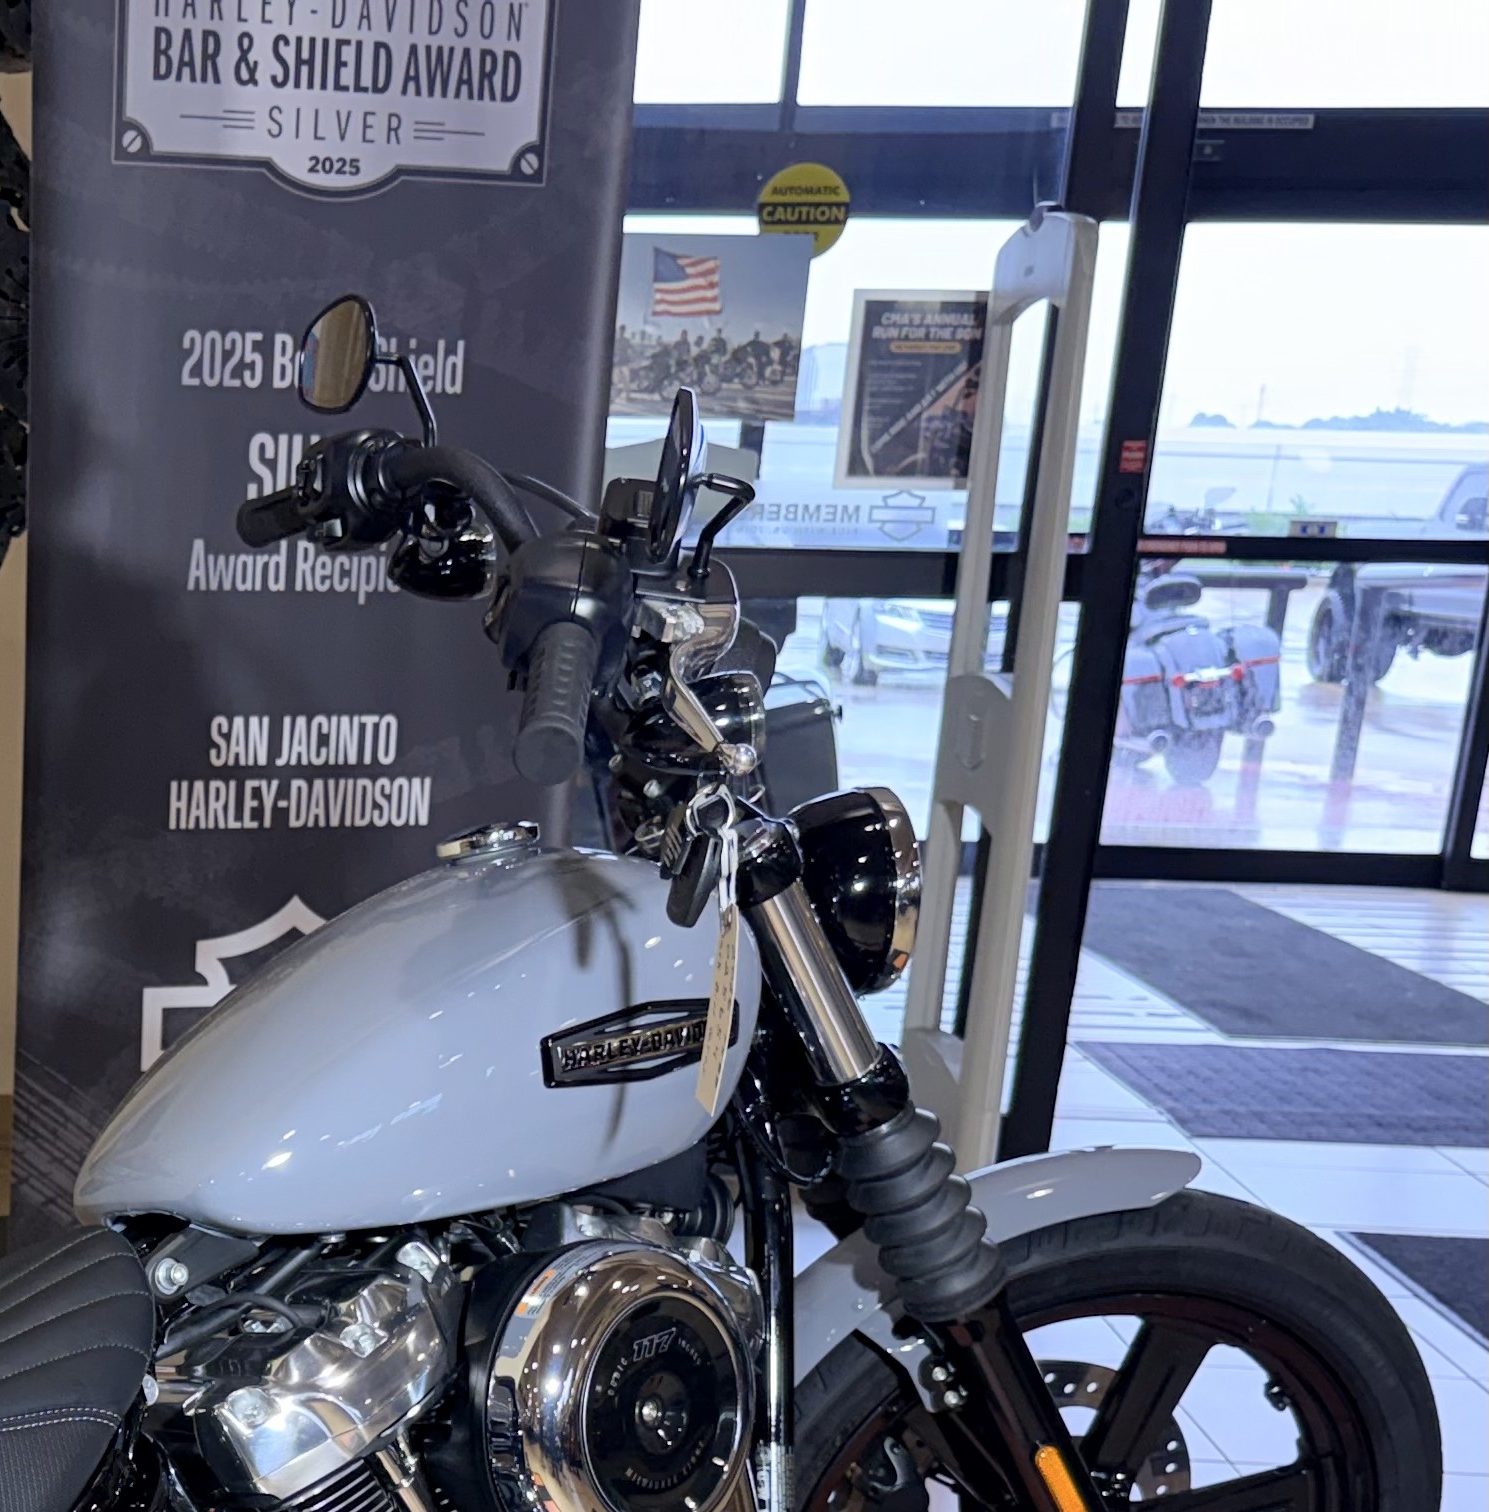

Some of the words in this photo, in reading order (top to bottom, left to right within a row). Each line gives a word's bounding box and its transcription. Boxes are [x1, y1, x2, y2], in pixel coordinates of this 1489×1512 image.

[152, 26, 222, 85] BAR
[234, 31, 260, 87] &
[269, 34, 393, 95] SHIELD
[400, 43, 523, 103] AWARD
[266, 104, 403, 146] SILVER
[307, 155, 361, 176] 2025
[772, 185, 841, 197] AUTOMATIC
[762, 205, 847, 223] CAUTION
[871, 325, 901, 340] RUN
[901, 326, 928, 340] FOR
[928, 326, 955, 340] THE
[923, 312, 976, 326] ANNUAL
[180, 329, 264, 389] 2025
[186, 538, 288, 592] Award
[294, 540, 401, 605] Recipi
[209, 714, 270, 767] SAN
[274, 713, 399, 767] JACINTO
[168, 776, 432, 830] HARLEY-DAVIDSON
[563, 1019, 707, 1072] HARLEY-DAVID
[632, 1327, 677, 1363] 117
